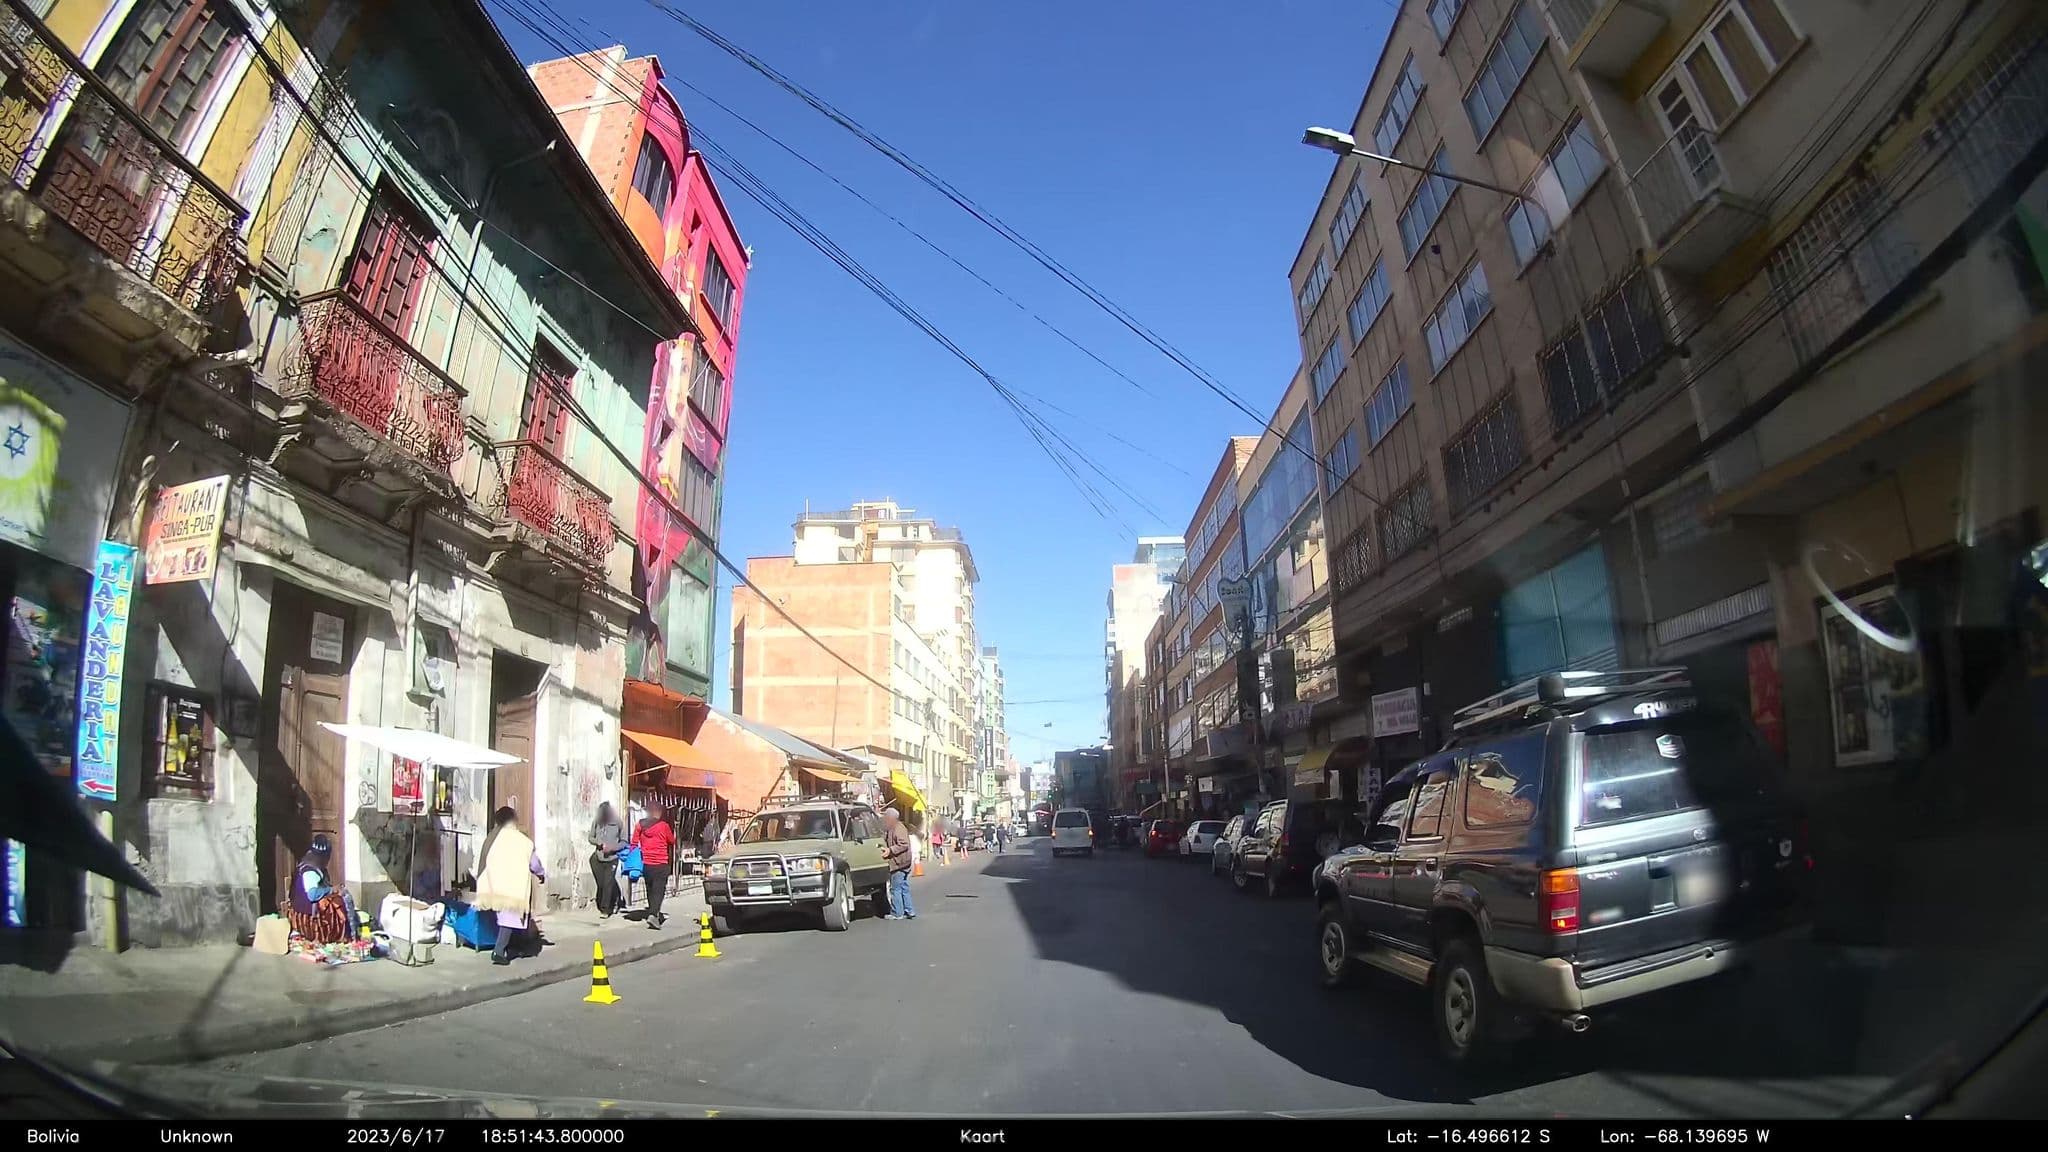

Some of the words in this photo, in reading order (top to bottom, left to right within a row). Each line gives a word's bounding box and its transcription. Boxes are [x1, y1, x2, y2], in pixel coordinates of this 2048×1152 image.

[160, 514, 215, 539] SINGA-PUR
[81, 562, 117, 763] LAVANDERIA
[103, 565, 129, 765] LAUNDRY
